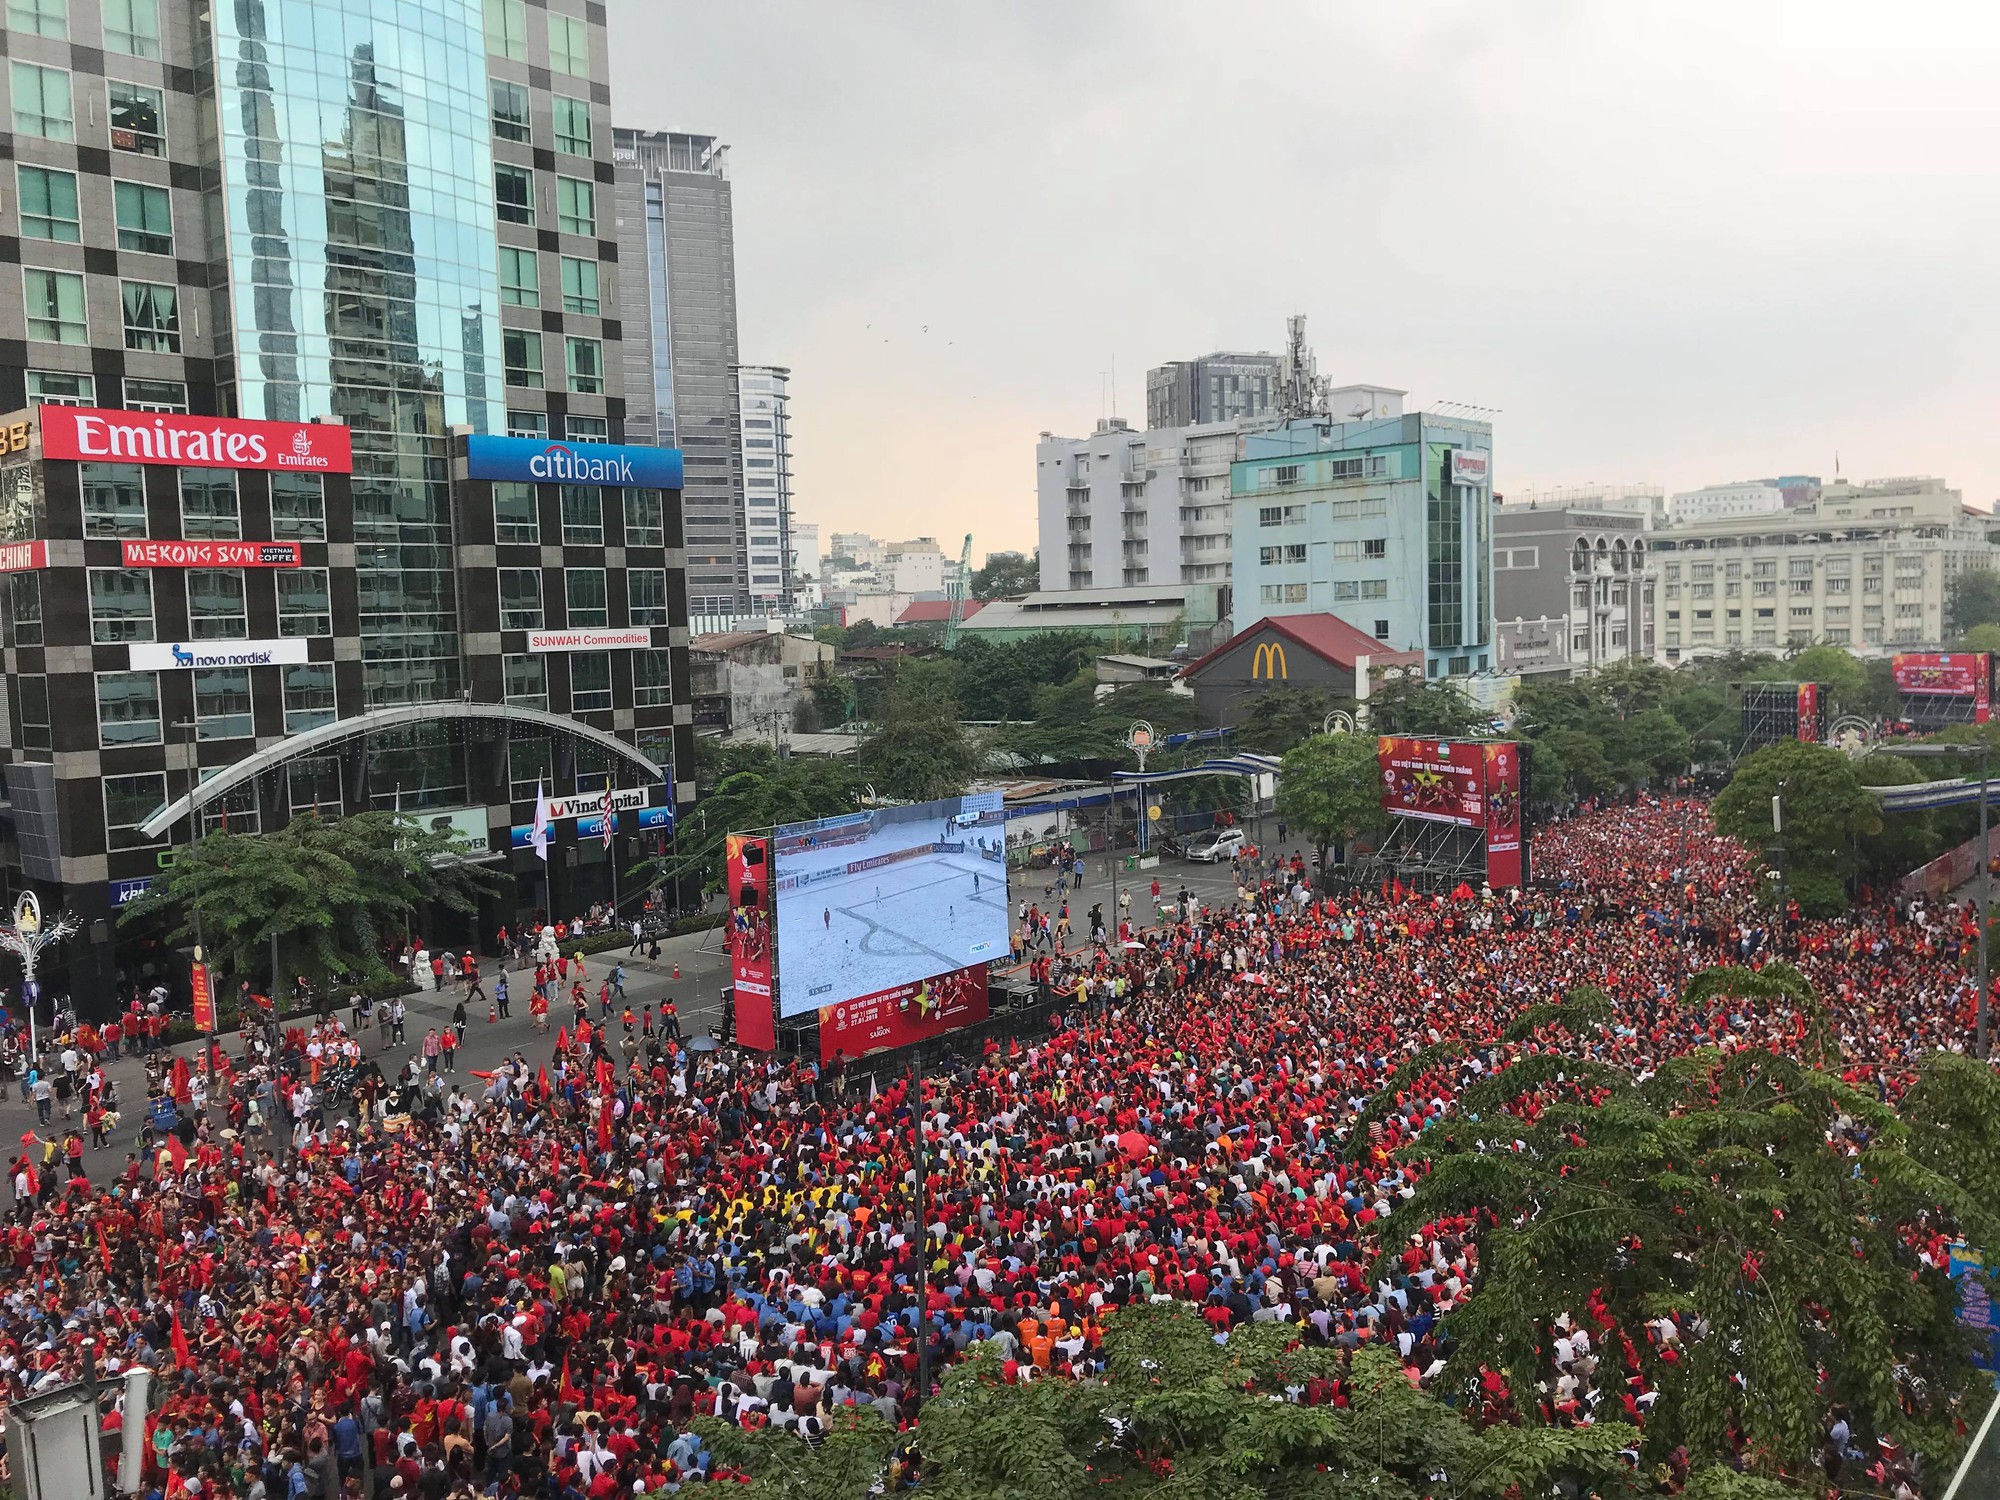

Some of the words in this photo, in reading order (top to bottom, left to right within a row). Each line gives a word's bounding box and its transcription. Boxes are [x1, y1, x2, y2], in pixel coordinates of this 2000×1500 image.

[74, 415, 267, 463] Emirates
[277, 453, 328, 467] Emirates
[529, 450, 634, 482] citibank
[0, 544, 32, 569] CHINA
[127, 544, 212, 564] MEKONG
[217, 545, 254, 563] SUN
[257, 554, 298, 562] COFFEE
[532, 636, 581, 647] SUNWAH
[583, 633, 648, 645] Commodities
[196, 656, 226, 666] novo
[229, 652, 271, 665] nordisk
[565, 790, 644, 815] VinaCpital
[589, 819, 604, 834] cit
[650, 813, 665, 824] citi
[850, 863, 861, 872] Fly
[862, 855, 890, 870] Emirates
